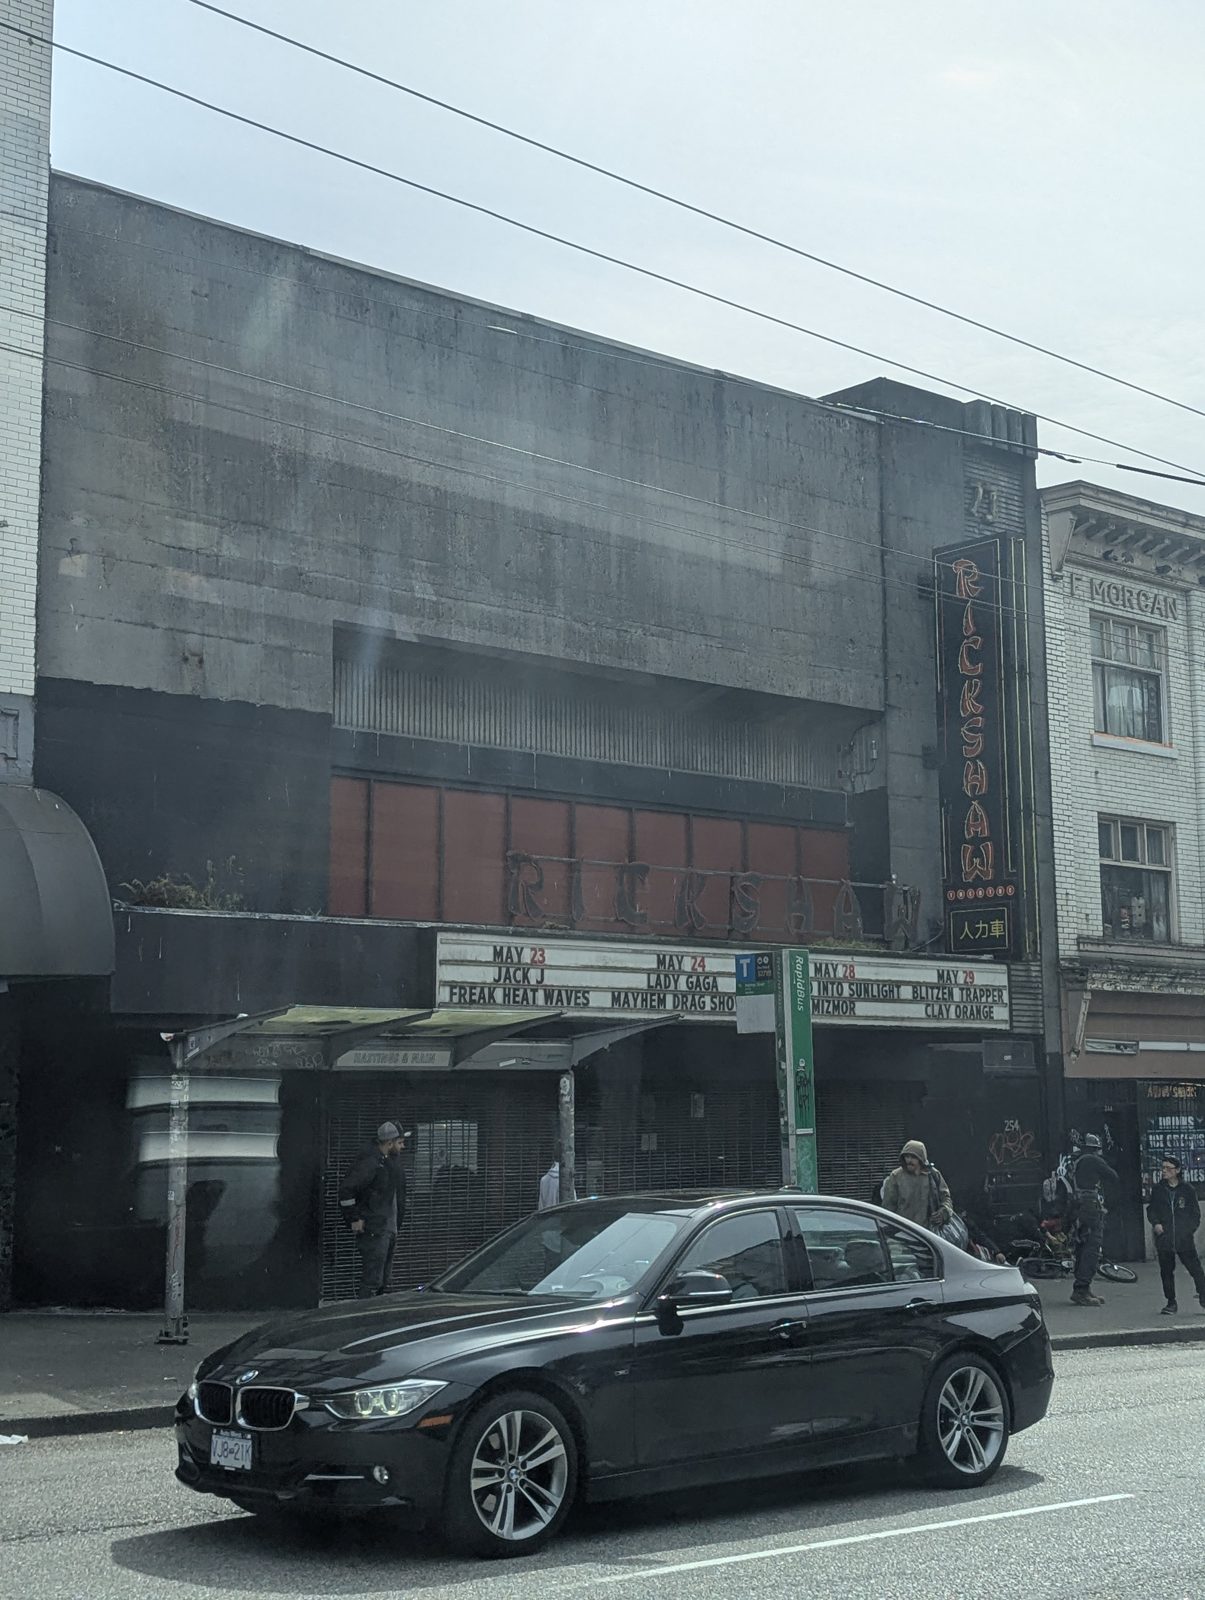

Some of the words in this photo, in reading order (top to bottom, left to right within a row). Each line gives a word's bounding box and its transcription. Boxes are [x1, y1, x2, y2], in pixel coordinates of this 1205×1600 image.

[1090, 578, 1178, 620] MORGAN
[952, 558, 994, 882] RICKSHAW
[506, 851, 921, 944] RICKSHAW
[960, 919, 1005, 940] 人力車
[493, 946, 524, 964] MAY
[530, 948, 546, 965] 23
[656, 954, 684, 971] MAY
[691, 956, 706, 972] 24
[493, 967, 530, 984] JACK
[536, 968, 545, 985] J
[814, 963, 838, 978] MAY
[842, 964, 856, 979] 28
[936, 969, 958, 984] MAY
[963, 970, 975, 985] 29
[647, 973, 679, 990] LADY
[686, 975, 719, 991] GAGA
[793, 955, 806, 1012] RapidBus
[817, 981, 844, 997] INTO
[849, 983, 901, 999] SUNLIGHT
[450, 986, 496, 1004] FREAK
[503, 988, 538, 1006] HEAT
[544, 989, 590, 1007] WAVES
[611, 991, 667, 1009] MAYHEM
[673, 993, 706, 1011] DRAG
[710, 994, 737, 1011] SHO
[912, 986, 954, 1001] BLITZEN
[960, 988, 1004, 1003] TRAPPER
[812, 1000, 856, 1015] MIZMOR
[925, 1003, 950, 1018] CLAY
[955, 1004, 994, 1020] ORANGE
[1004, 1119, 1020, 1131] 254
